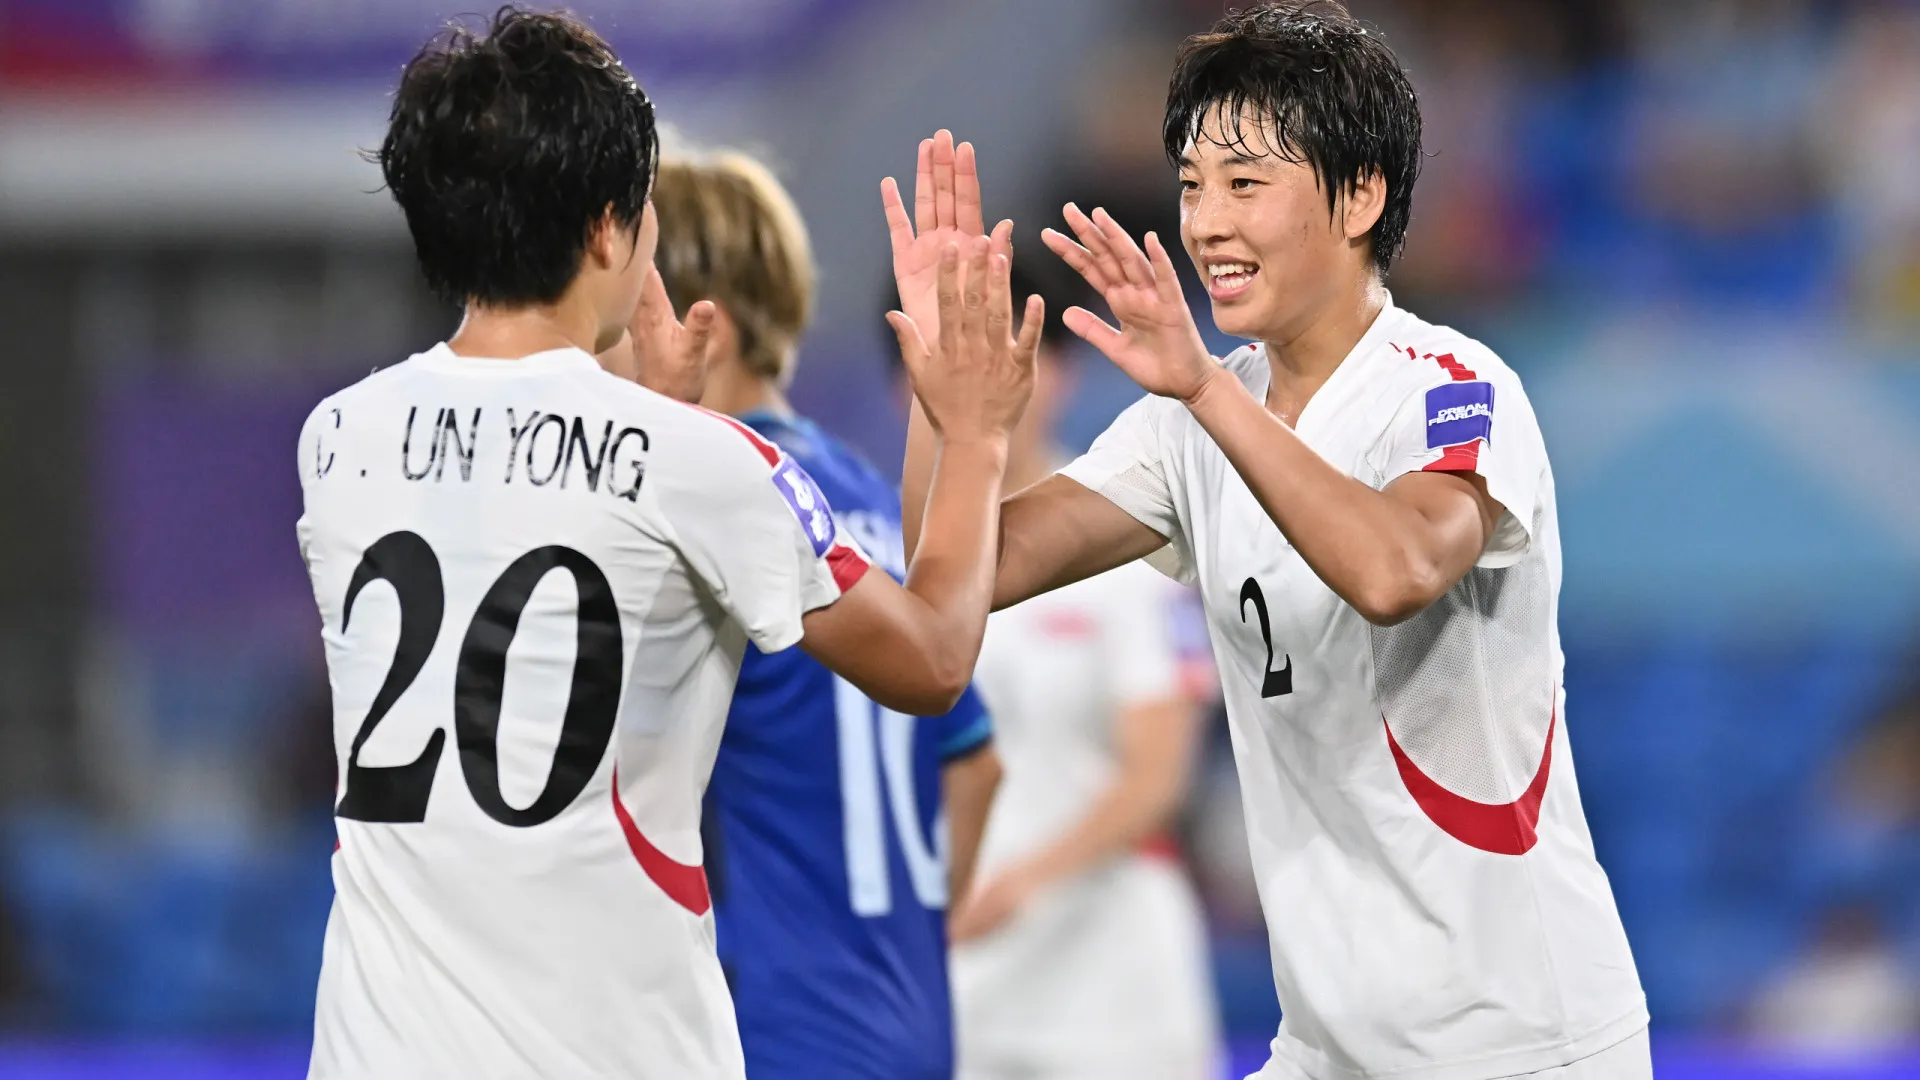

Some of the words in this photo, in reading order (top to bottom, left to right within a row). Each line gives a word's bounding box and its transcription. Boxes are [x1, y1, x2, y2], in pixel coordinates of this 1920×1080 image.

[401, 406, 482, 483] UN
[505, 407, 650, 502] YONG
[1437, 403, 1489, 417] DREAM
[334, 530, 624, 828] 20
[1240, 577, 1293, 698] 2
